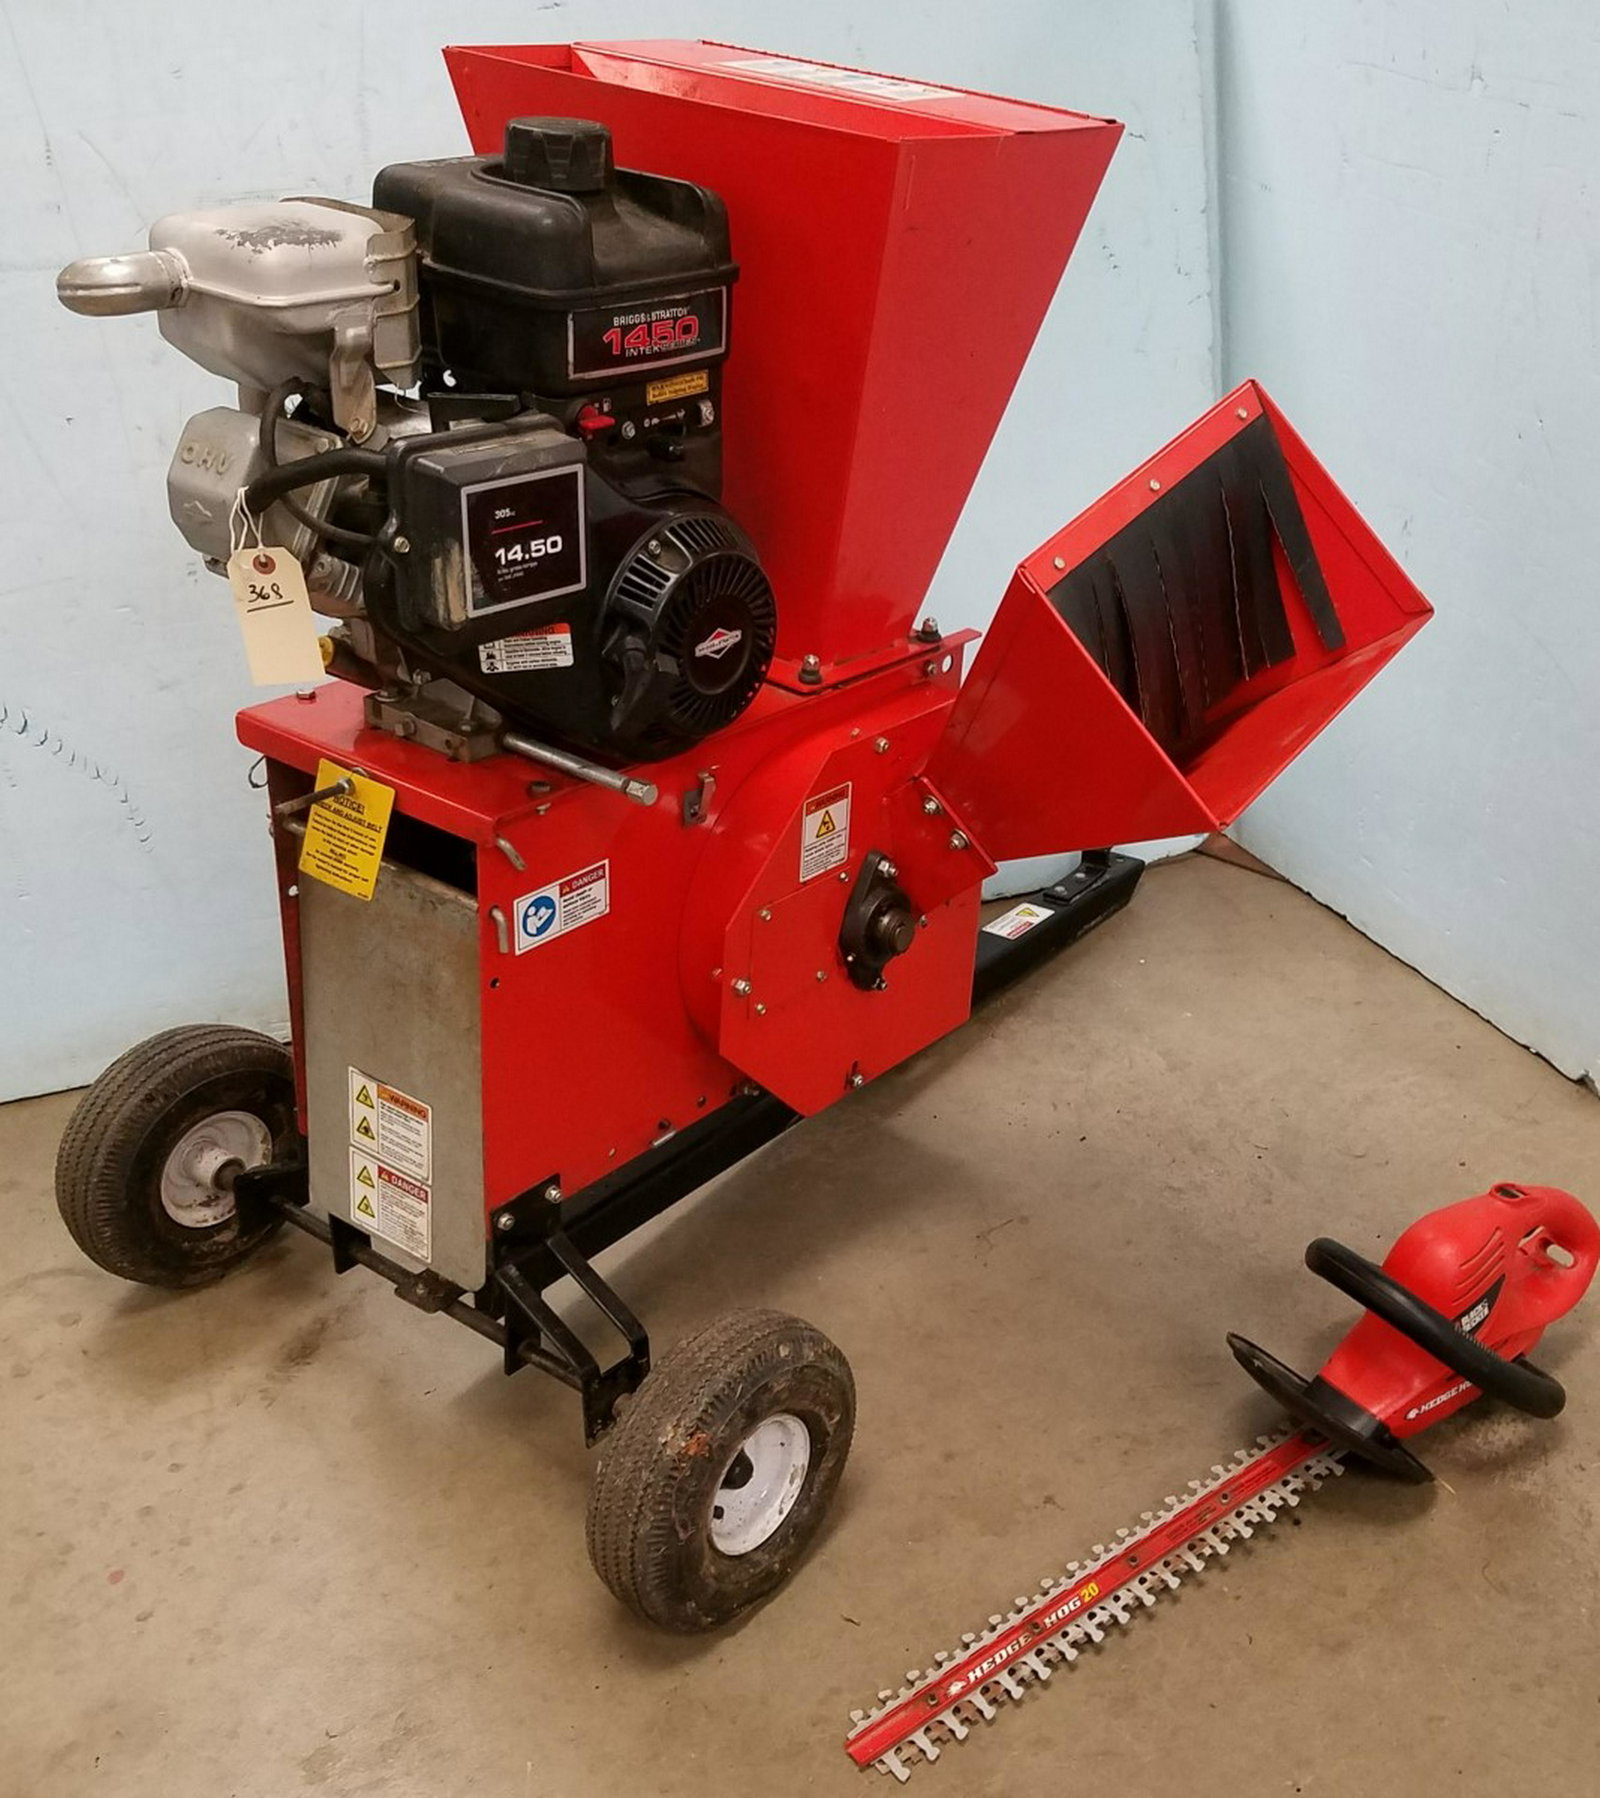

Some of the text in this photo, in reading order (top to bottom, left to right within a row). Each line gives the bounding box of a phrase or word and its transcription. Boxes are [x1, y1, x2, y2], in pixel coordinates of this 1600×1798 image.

[602, 315, 699, 355] 1450
[494, 534, 563, 566] 14.50
[247, 583, 284, 603] 368
[571, 868, 605, 889] DANGER
[391, 1175, 427, 1201] DANGER
[967, 1582, 1099, 1683] HEDGE HOG 20
